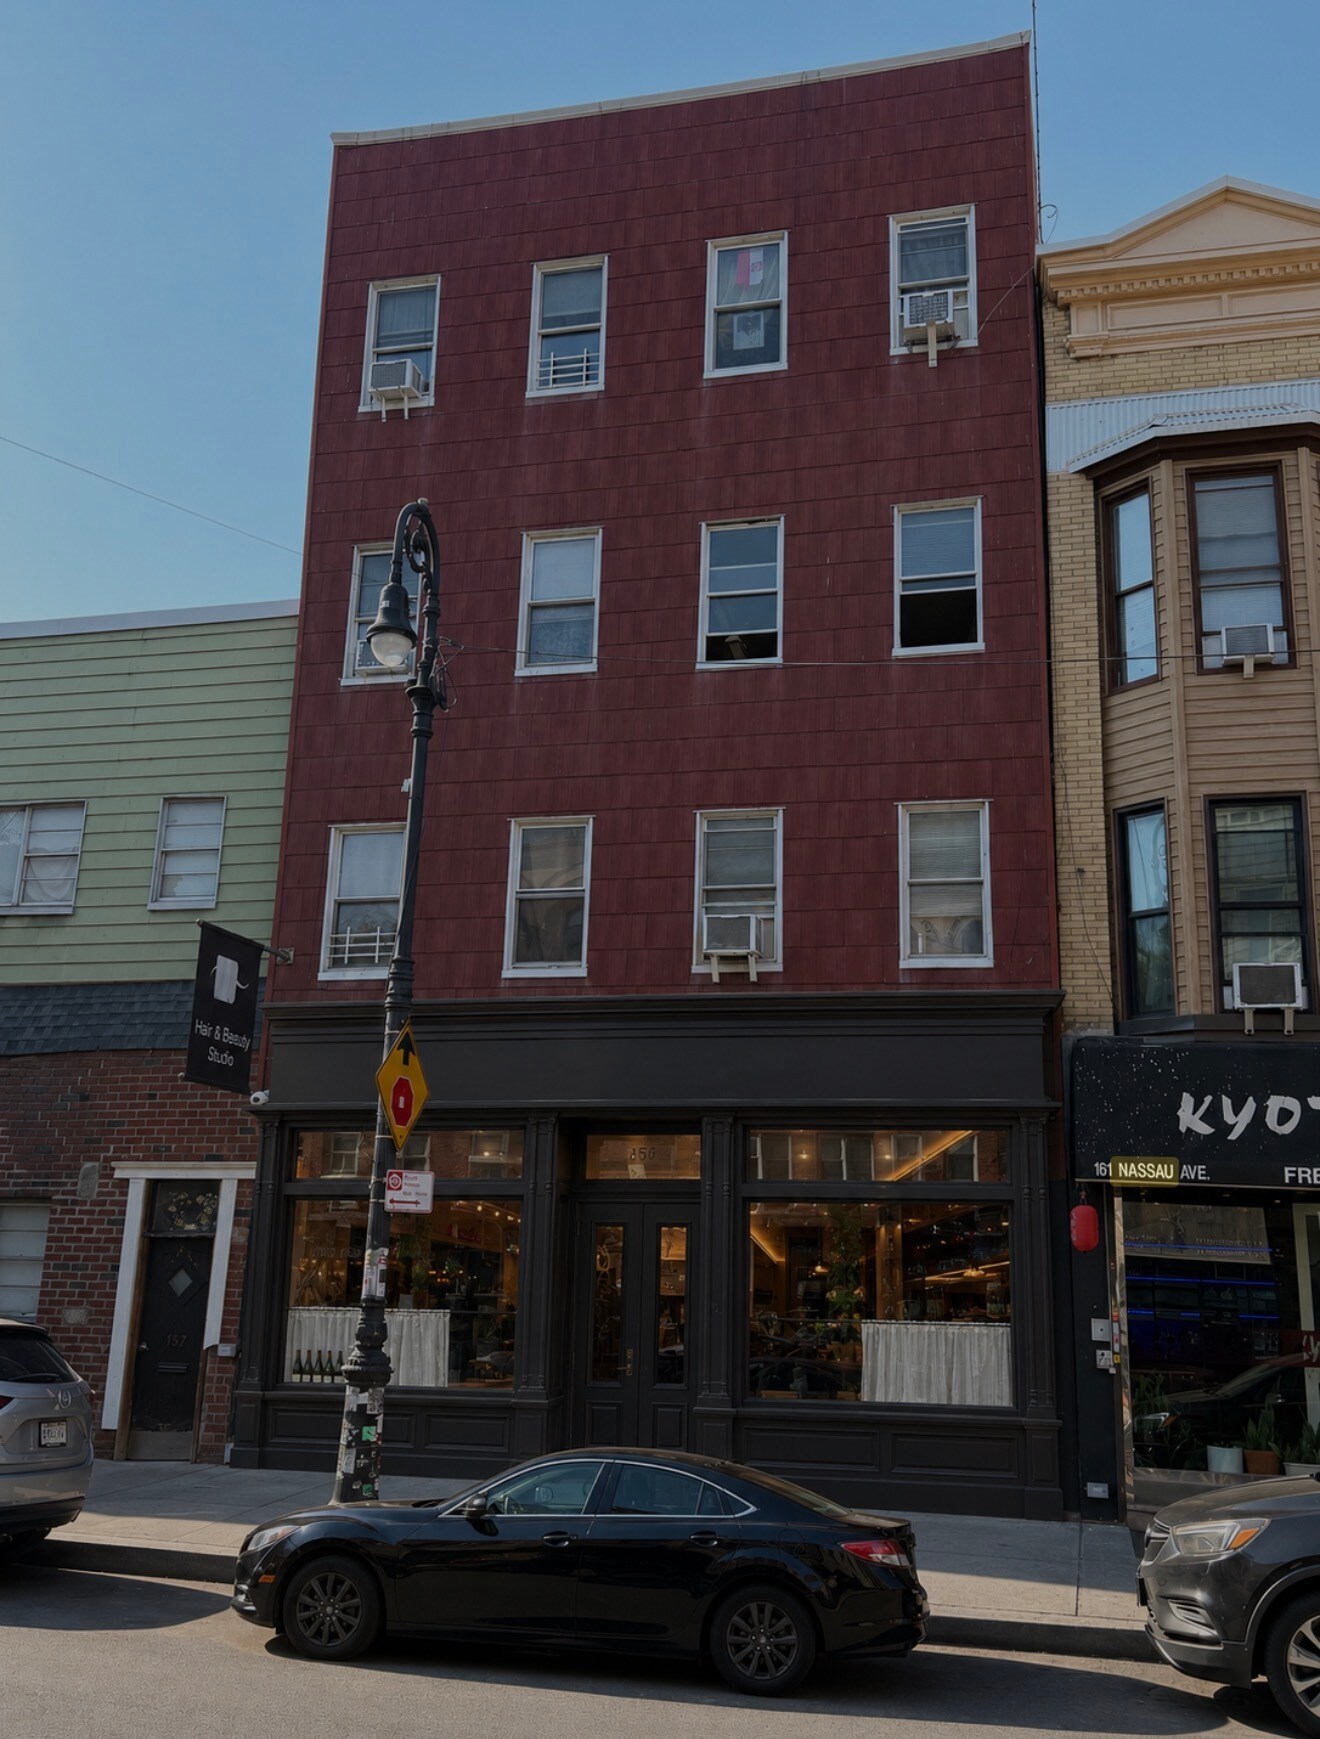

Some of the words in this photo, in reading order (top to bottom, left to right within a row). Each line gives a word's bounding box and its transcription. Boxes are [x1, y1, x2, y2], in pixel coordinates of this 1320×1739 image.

[194, 1018, 213, 1038] Hair
[213, 1025, 222, 1041] &
[222, 1027, 252, 1052] Beauty
[207, 1046, 235, 1067] Studio
[1093, 1162, 1112, 1177] 161
[1118, 1162, 1174, 1179] NASSAU
[1180, 1165, 1210, 1181] AVE.
[167, 1334, 187, 1348] 157
